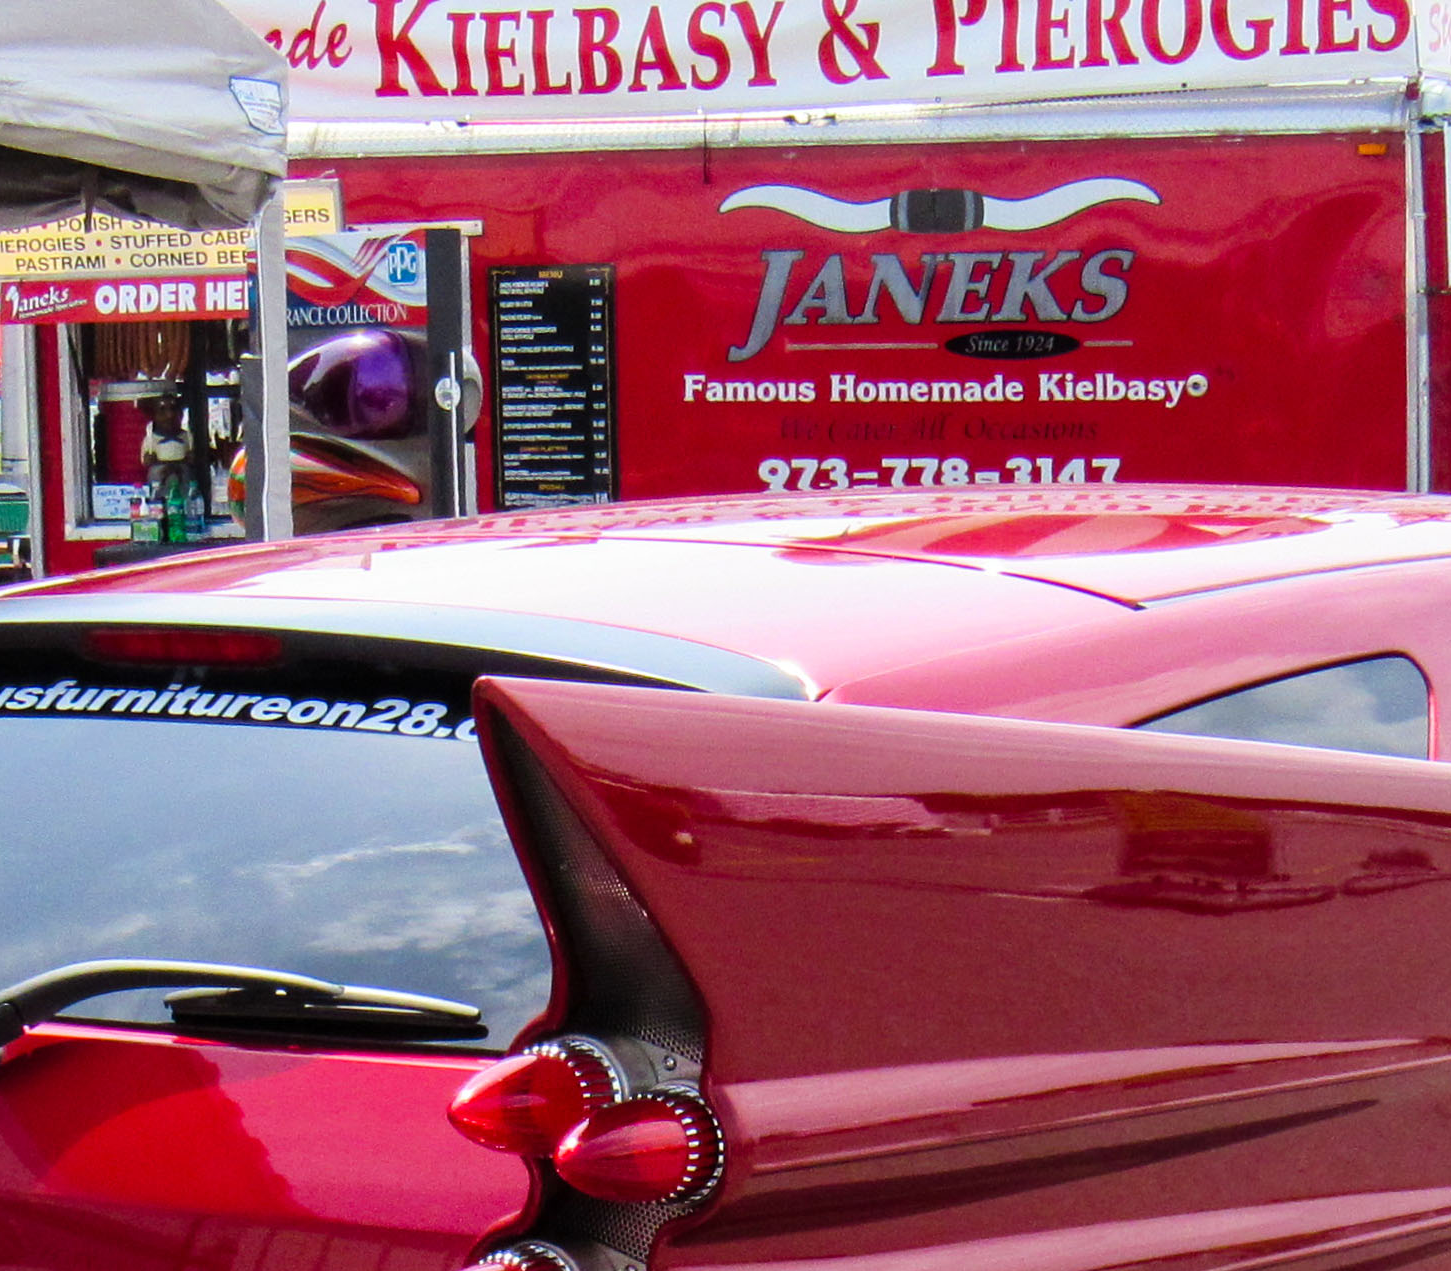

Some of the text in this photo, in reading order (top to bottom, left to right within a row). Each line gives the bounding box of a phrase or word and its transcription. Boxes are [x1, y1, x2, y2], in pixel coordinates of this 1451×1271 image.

[375, 0, 785, 97] KIELBASY
[817, 0, 890, 84] &
[926, 0, 1412, 77] PIEROGIES
[57, 217, 122, 232] POISH
[110, 233, 192, 249] STUFFED
[16, 255, 106, 272] PASTRAMI
[130, 252, 208, 268] CORNED
[389, 246, 417, 281] PPG
[94, 284, 197, 315] ORDER
[726, 248, 1136, 362] JANEKS
[326, 304, 408, 326] COLLECTION
[965, 334, 1055, 354] Since 1924
[683, 372, 1187, 408] Famous Homemade Kielbasy
